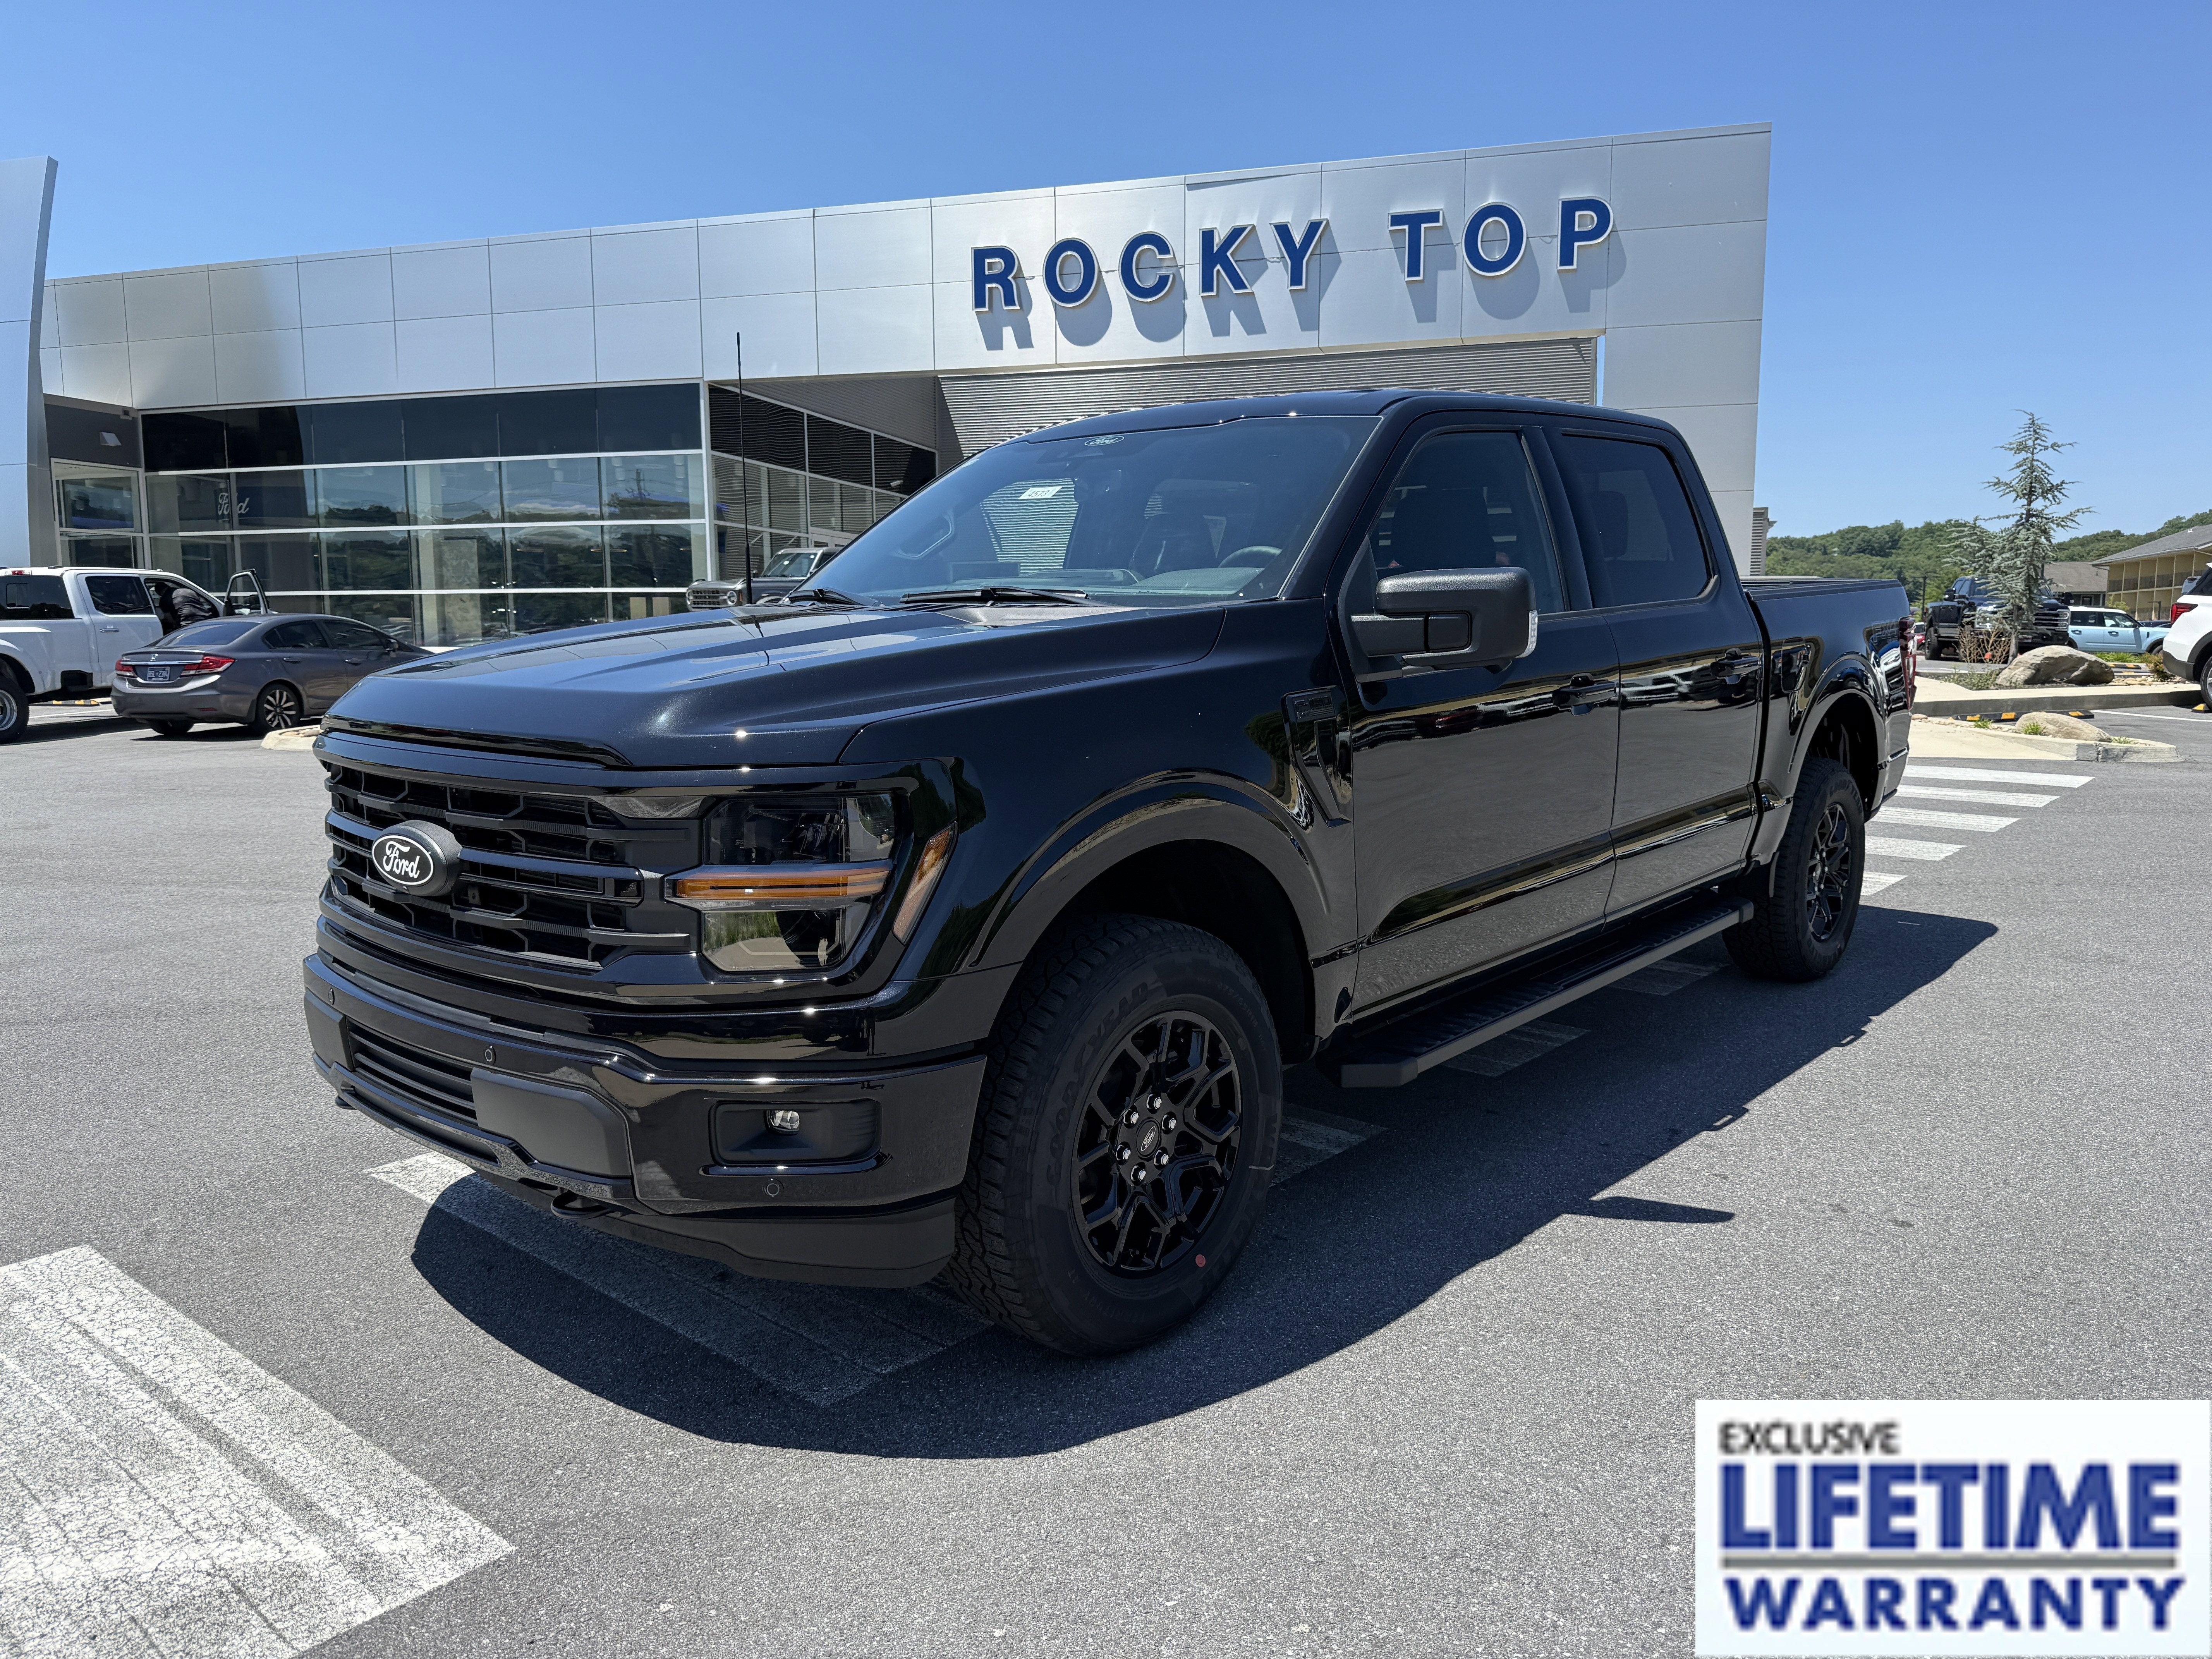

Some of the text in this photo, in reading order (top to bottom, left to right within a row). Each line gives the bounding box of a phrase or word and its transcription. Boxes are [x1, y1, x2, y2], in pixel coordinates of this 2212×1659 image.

[972, 196, 1613, 312] ROCKY TOP
[218, 493, 249, 515] Fod
[383, 841, 420, 878] Ford
[1144, 1130, 1154, 1147] Ford
